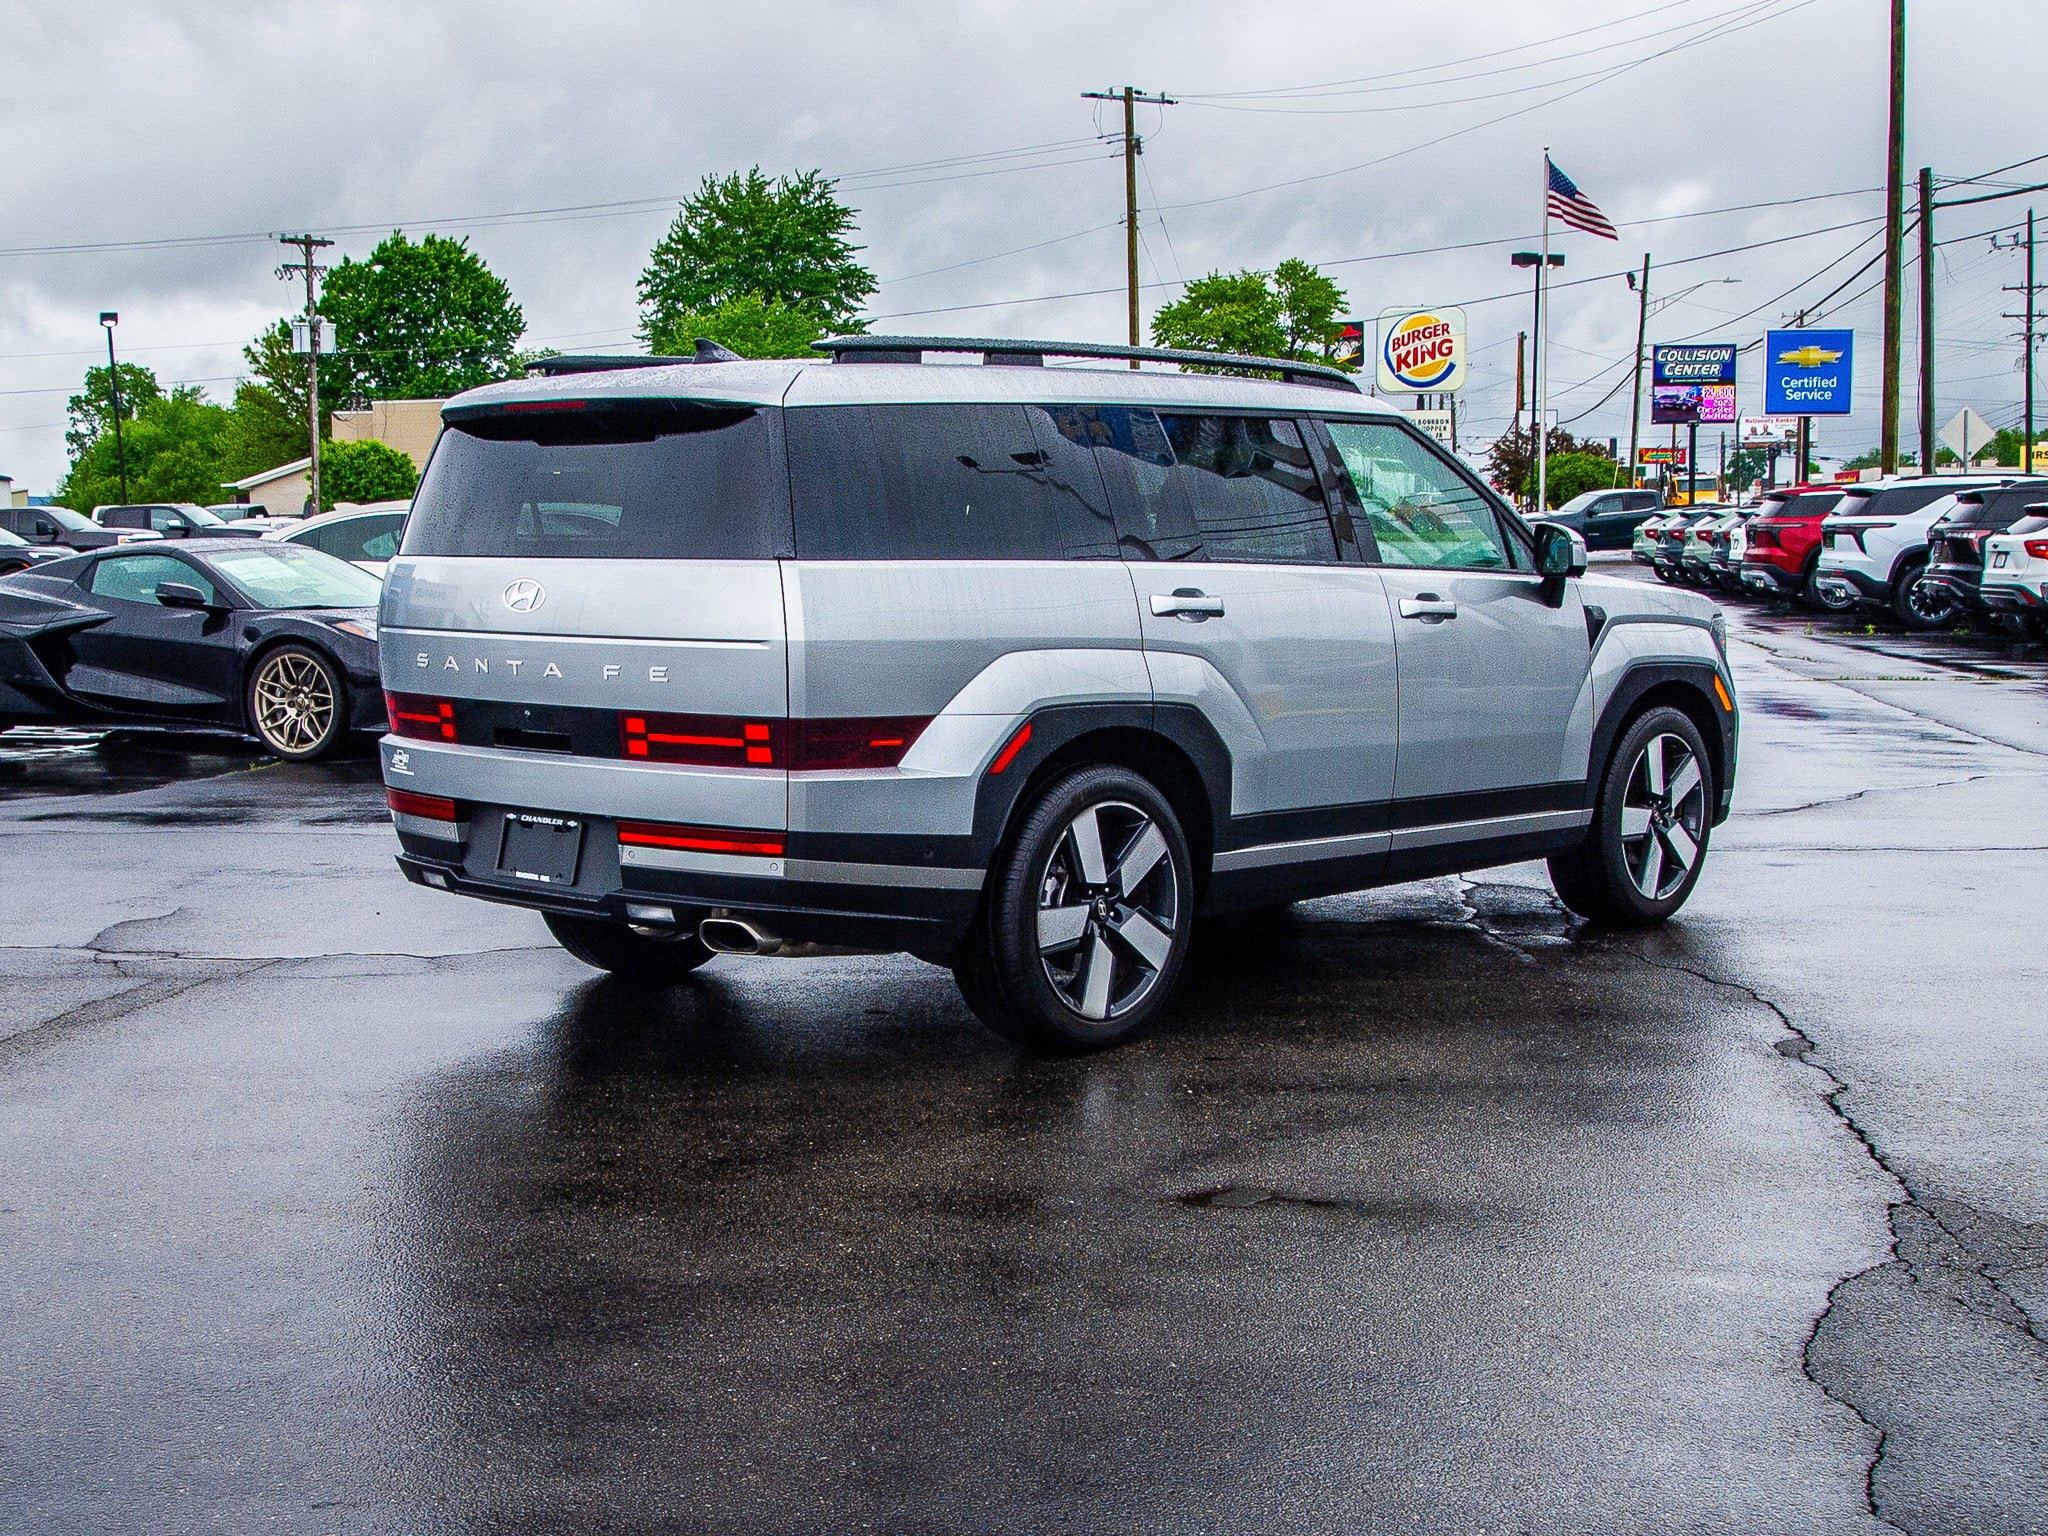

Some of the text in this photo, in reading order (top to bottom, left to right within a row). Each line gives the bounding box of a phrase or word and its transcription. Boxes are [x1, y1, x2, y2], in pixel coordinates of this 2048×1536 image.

[1392, 322, 1450, 353] BURGER
[1395, 338, 1453, 373] KING
[1657, 348, 1732, 362] COLLISION
[1664, 363, 1720, 376] CENTER
[1781, 376, 1837, 389] Certified
[1785, 388, 1832, 401] Service
[416, 652, 670, 683] SANTA FE
[521, 814, 563, 826] CHANDLER
